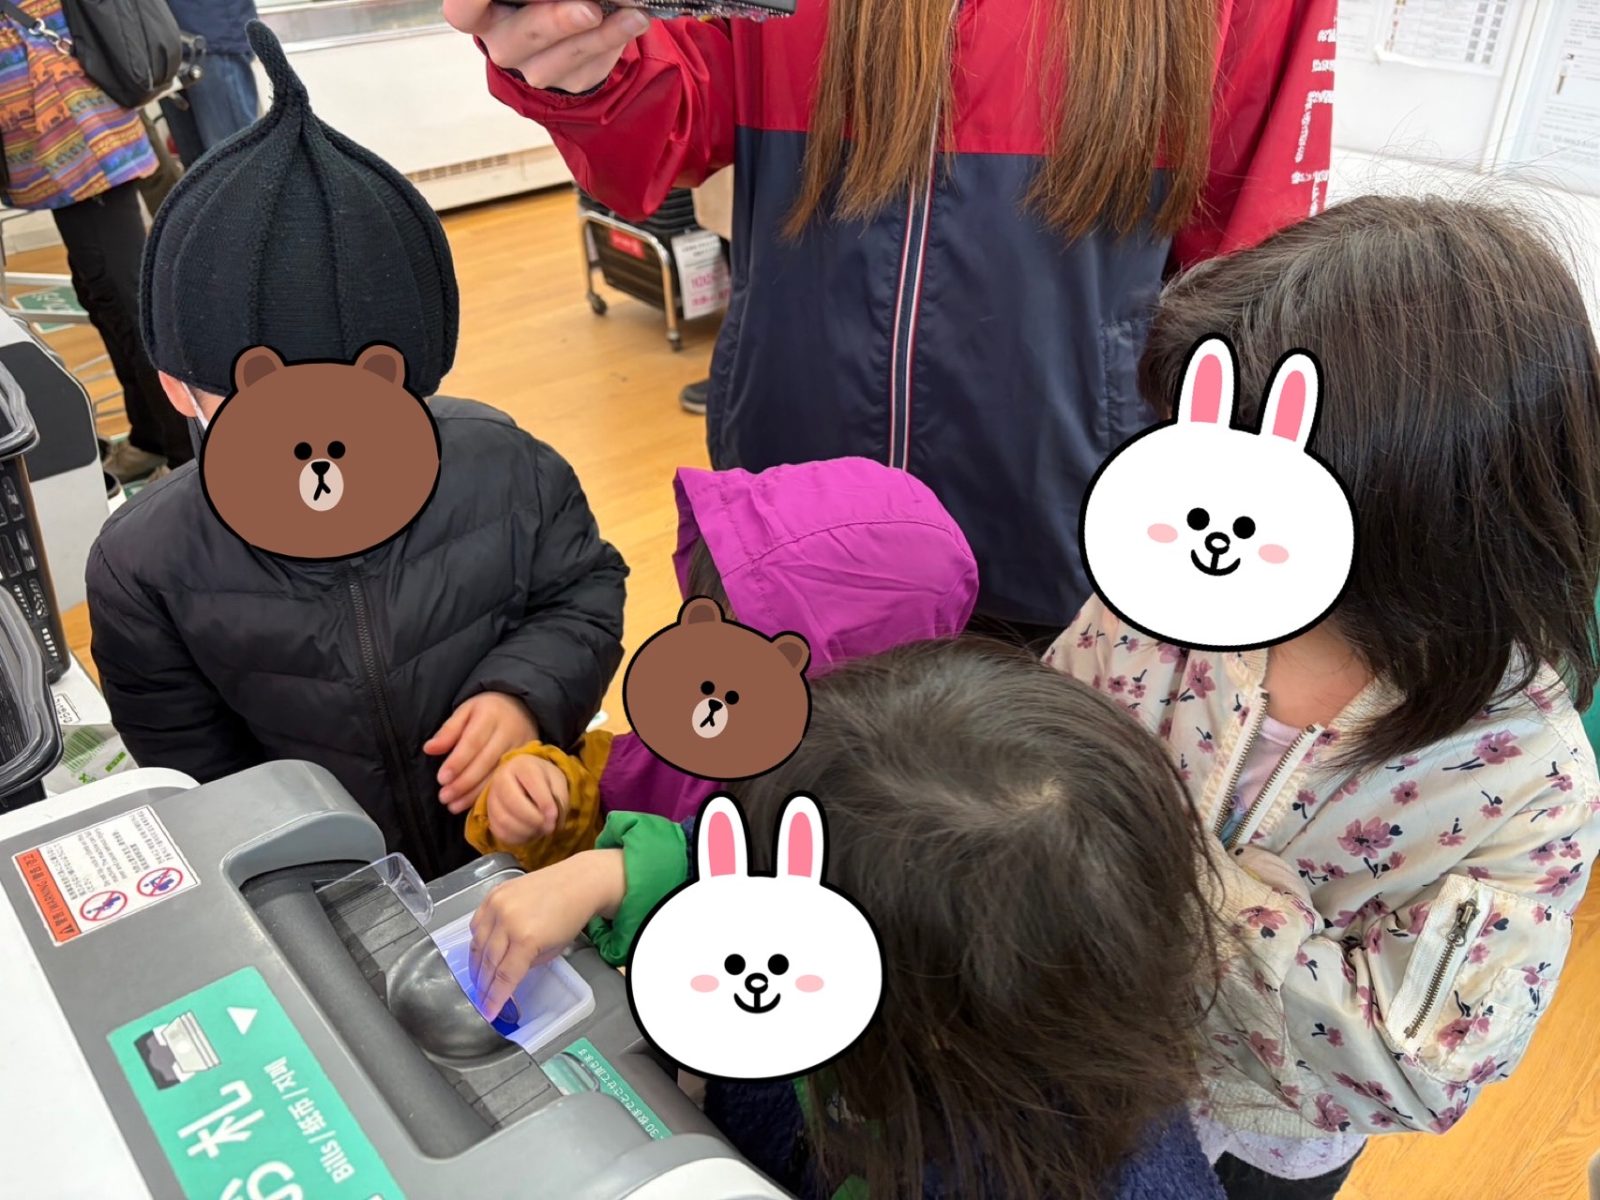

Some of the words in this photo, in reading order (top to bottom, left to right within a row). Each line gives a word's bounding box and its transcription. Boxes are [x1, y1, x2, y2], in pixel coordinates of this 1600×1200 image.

[35, 879, 60, 910] WARNING
[264, 1056, 297, 1093] 지폐
[320, 1139, 355, 1184] Bills
